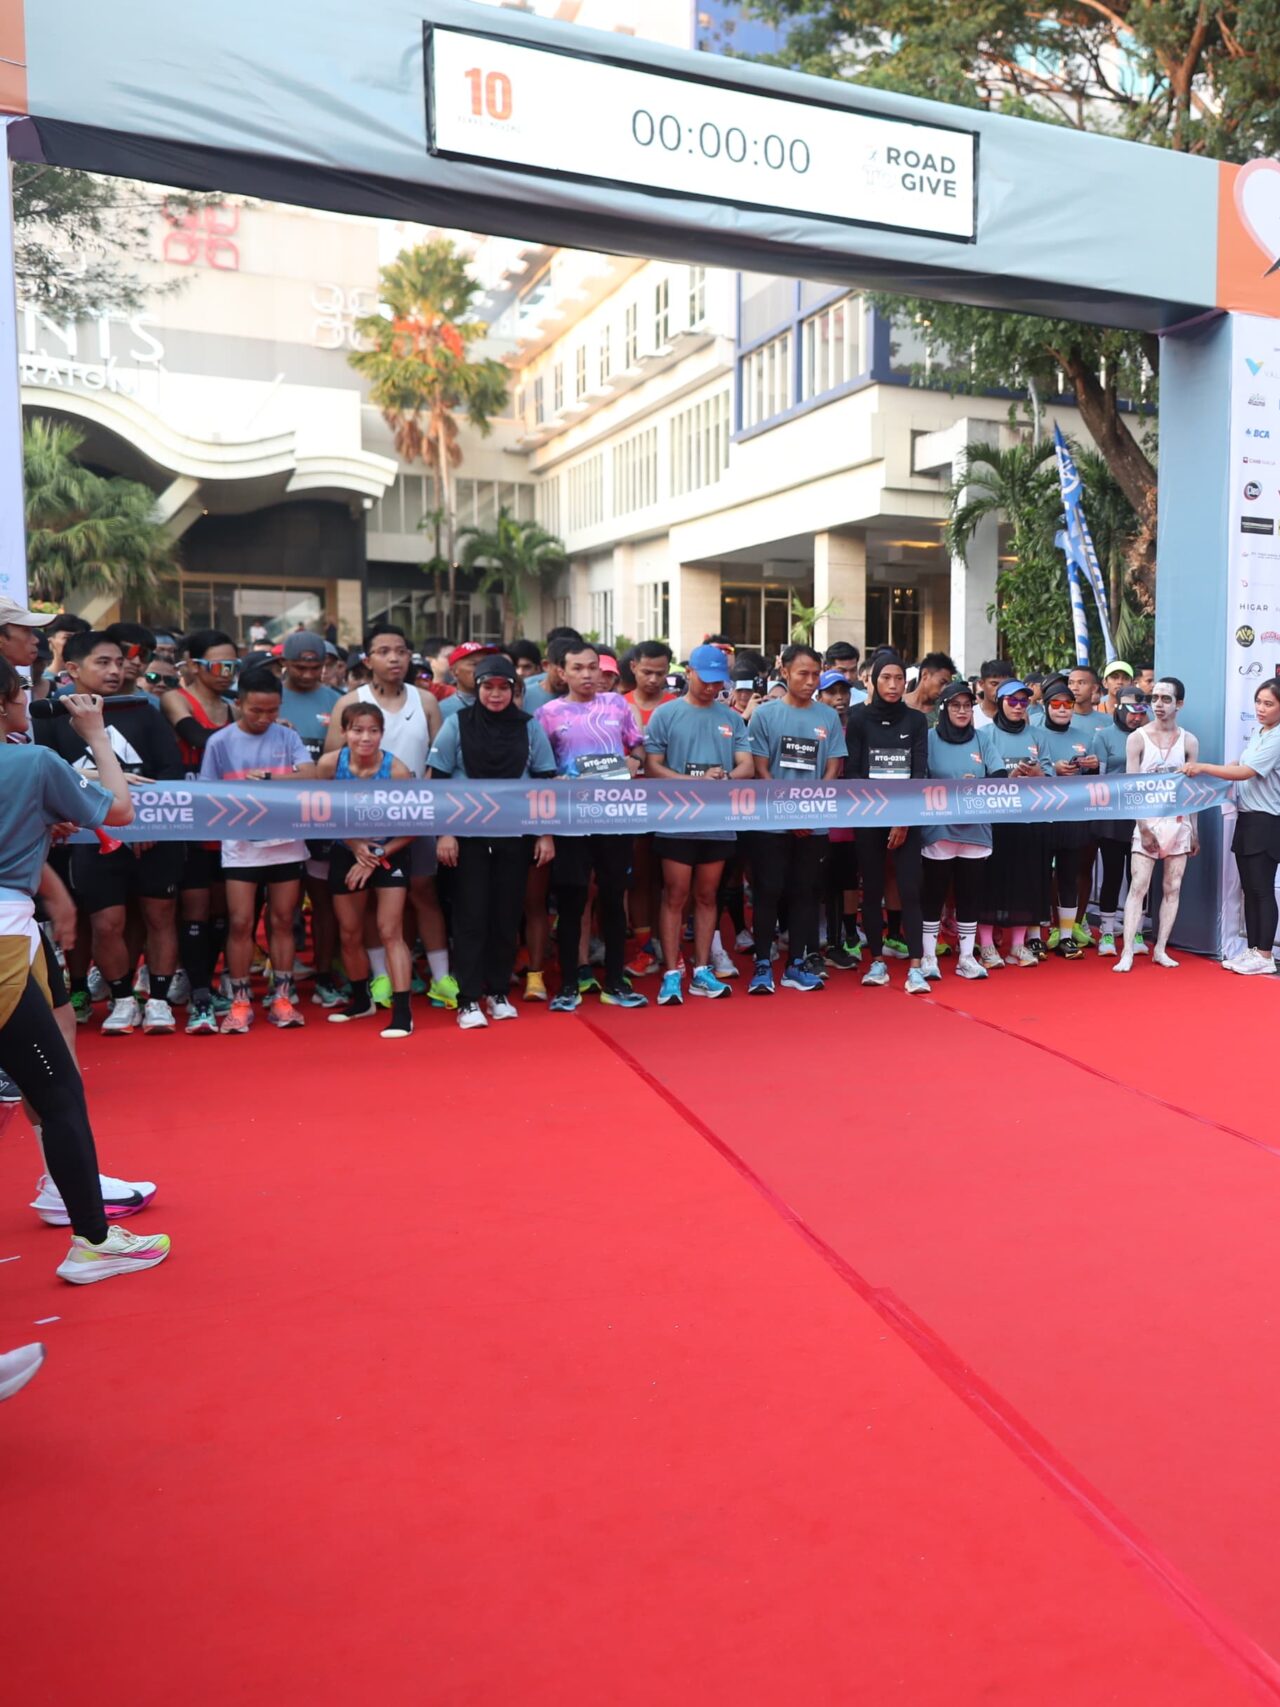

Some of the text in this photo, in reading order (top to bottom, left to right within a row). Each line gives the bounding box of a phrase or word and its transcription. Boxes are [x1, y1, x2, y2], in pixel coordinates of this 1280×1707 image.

[464, 67, 513, 121] 10
[631, 109, 811, 175] 00:00:00
[886, 146, 957, 174] ROAD
[901, 172, 958, 199] GIVE
[1253, 428, 1270, 439] BCA
[789, 787, 837, 799] ROAD
[976, 784, 1019, 796] ROAD
[1135, 780, 1176, 791] ROAD
[131, 790, 193, 806] ROAD
[374, 790, 434, 804] ROAD
[594, 789, 648, 802] ROAD
[728, 788, 756, 815] 10
[922, 785, 948, 811] 10
[1085, 782, 1111, 807] 10
[1124, 792, 1177, 804] TO GIVE
[296, 790, 332, 822] 10
[526, 789, 557, 819] 10
[773, 800, 838, 814] TO GIVE
[963, 796, 1023, 809] TO GIVE
[139, 807, 194, 823] GIVE
[354, 806, 435, 821] TO GIVE
[576, 803, 649, 818] TO GIVE
